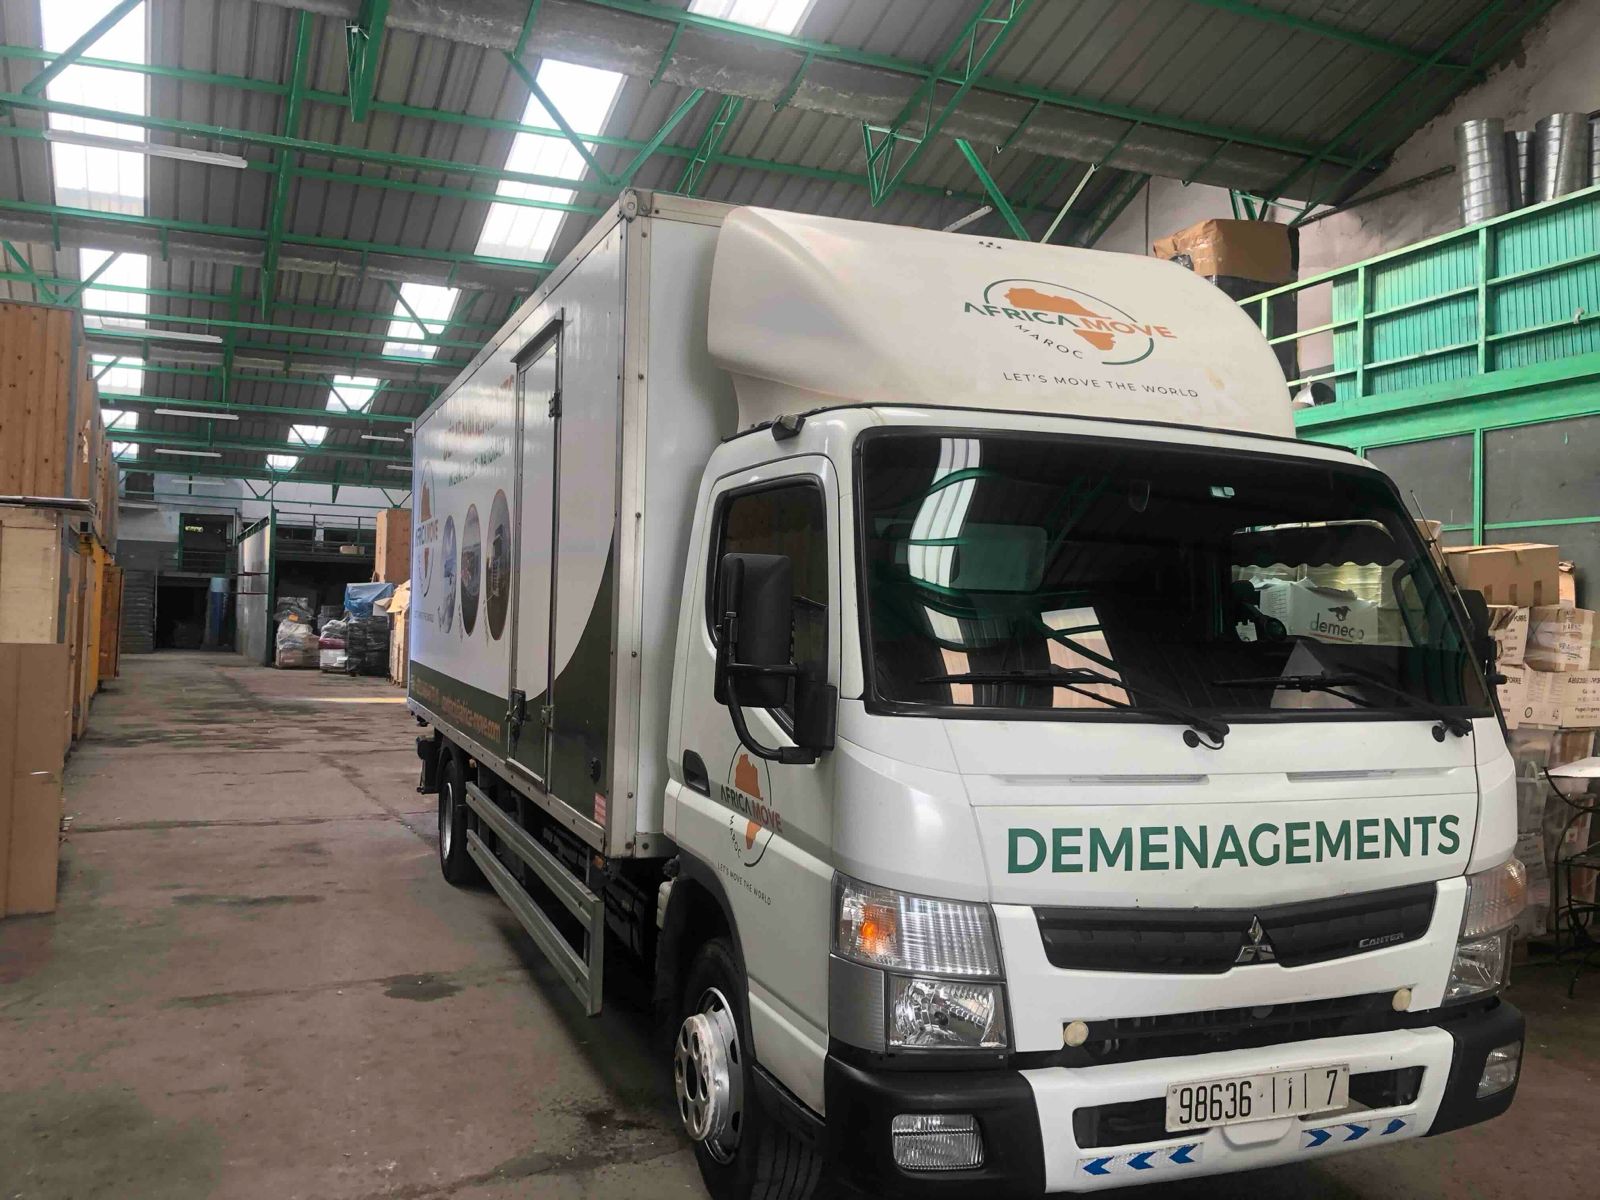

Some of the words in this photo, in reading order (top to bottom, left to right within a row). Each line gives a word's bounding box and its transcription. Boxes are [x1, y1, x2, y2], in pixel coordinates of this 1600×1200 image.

[1014, 324, 1084, 360] MAROC
[1002, 372, 1048, 384] LET'S
[1054, 376, 1101, 388] MOVE
[1106, 380, 1136, 392] THE
[1141, 384, 1199, 398] WORLD
[1310, 612, 1365, 641] demeco
[1007, 814, 1461, 874] DEMENAGEMENTS
[729, 870, 743, 886] MOVE
[743, 879, 752, 893] THE
[753, 887, 772, 906] WORLD
[1179, 1081, 1252, 1124] 98636
[1326, 1069, 1338, 1106] 7
